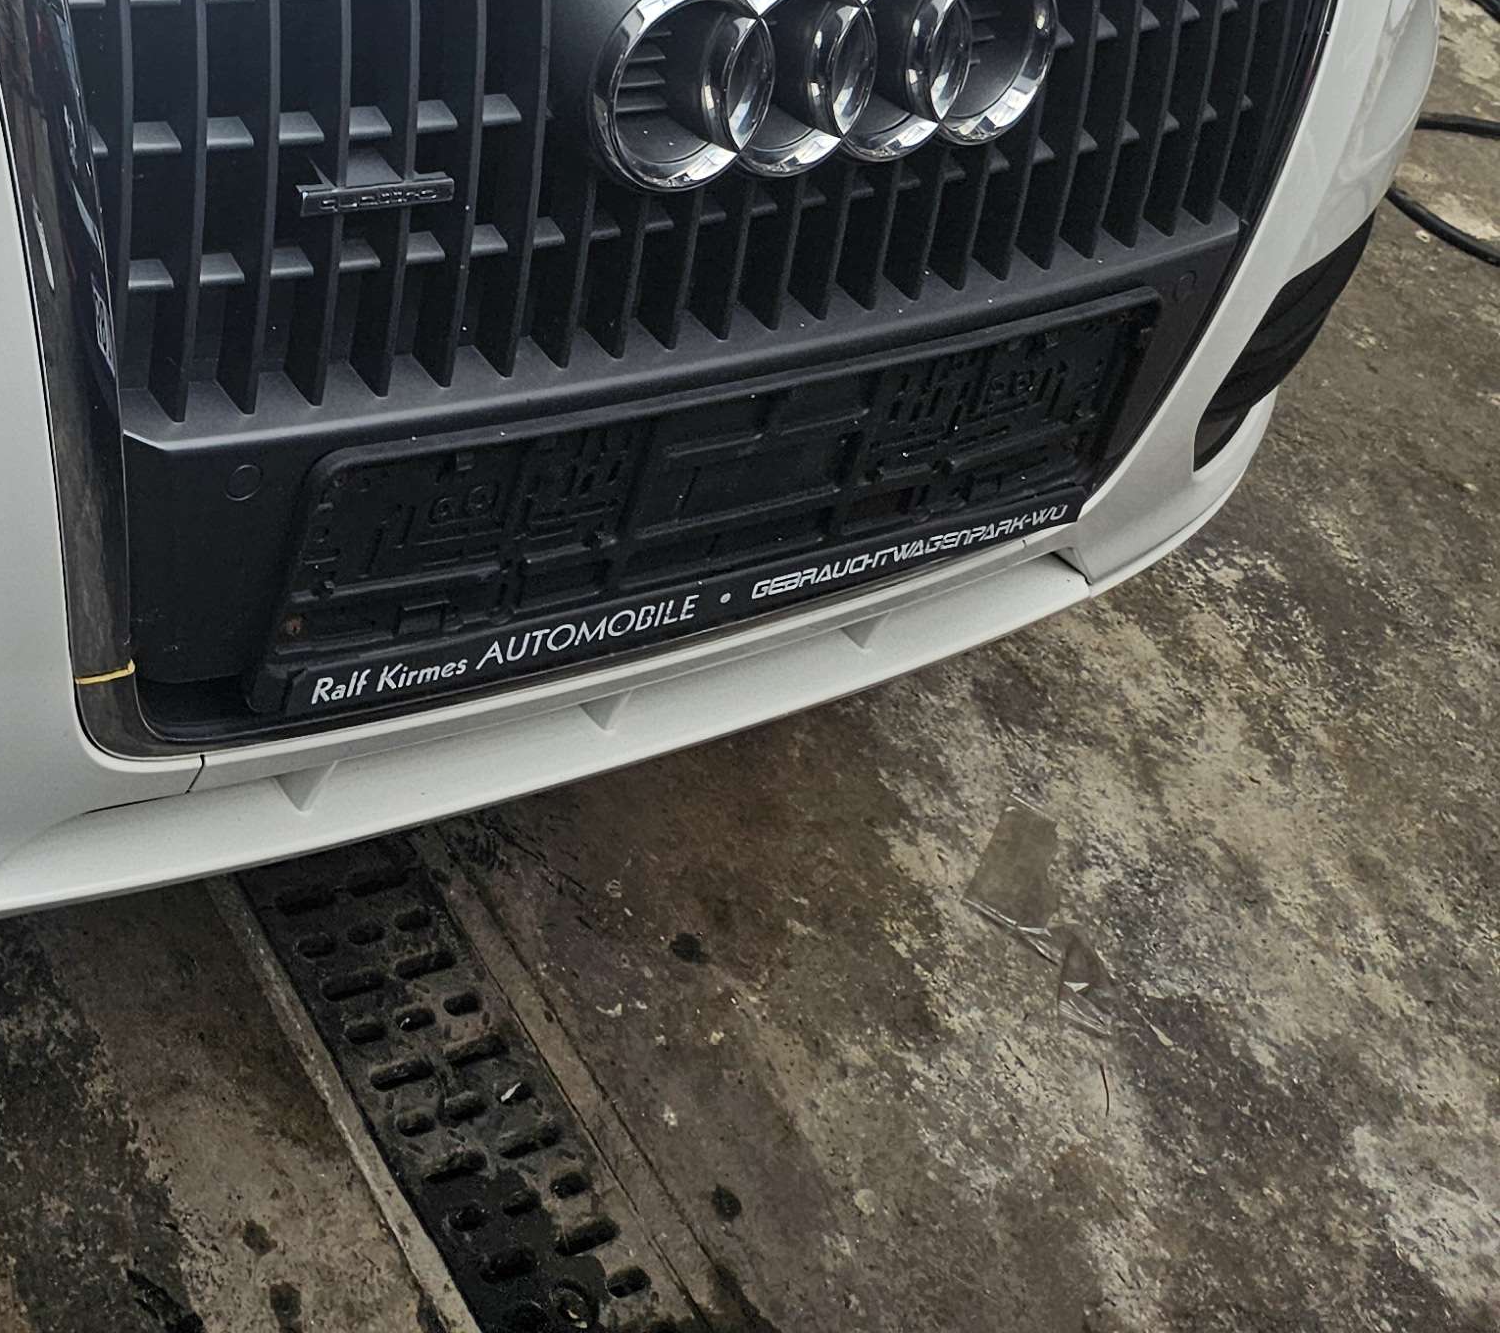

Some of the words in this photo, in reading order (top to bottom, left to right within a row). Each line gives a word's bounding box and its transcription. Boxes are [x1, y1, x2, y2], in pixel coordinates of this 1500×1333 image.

[311, 659, 371, 704] Ralf
[376, 653, 468, 692] Kirmes
[476, 594, 699, 670] AUTOMOBILE
